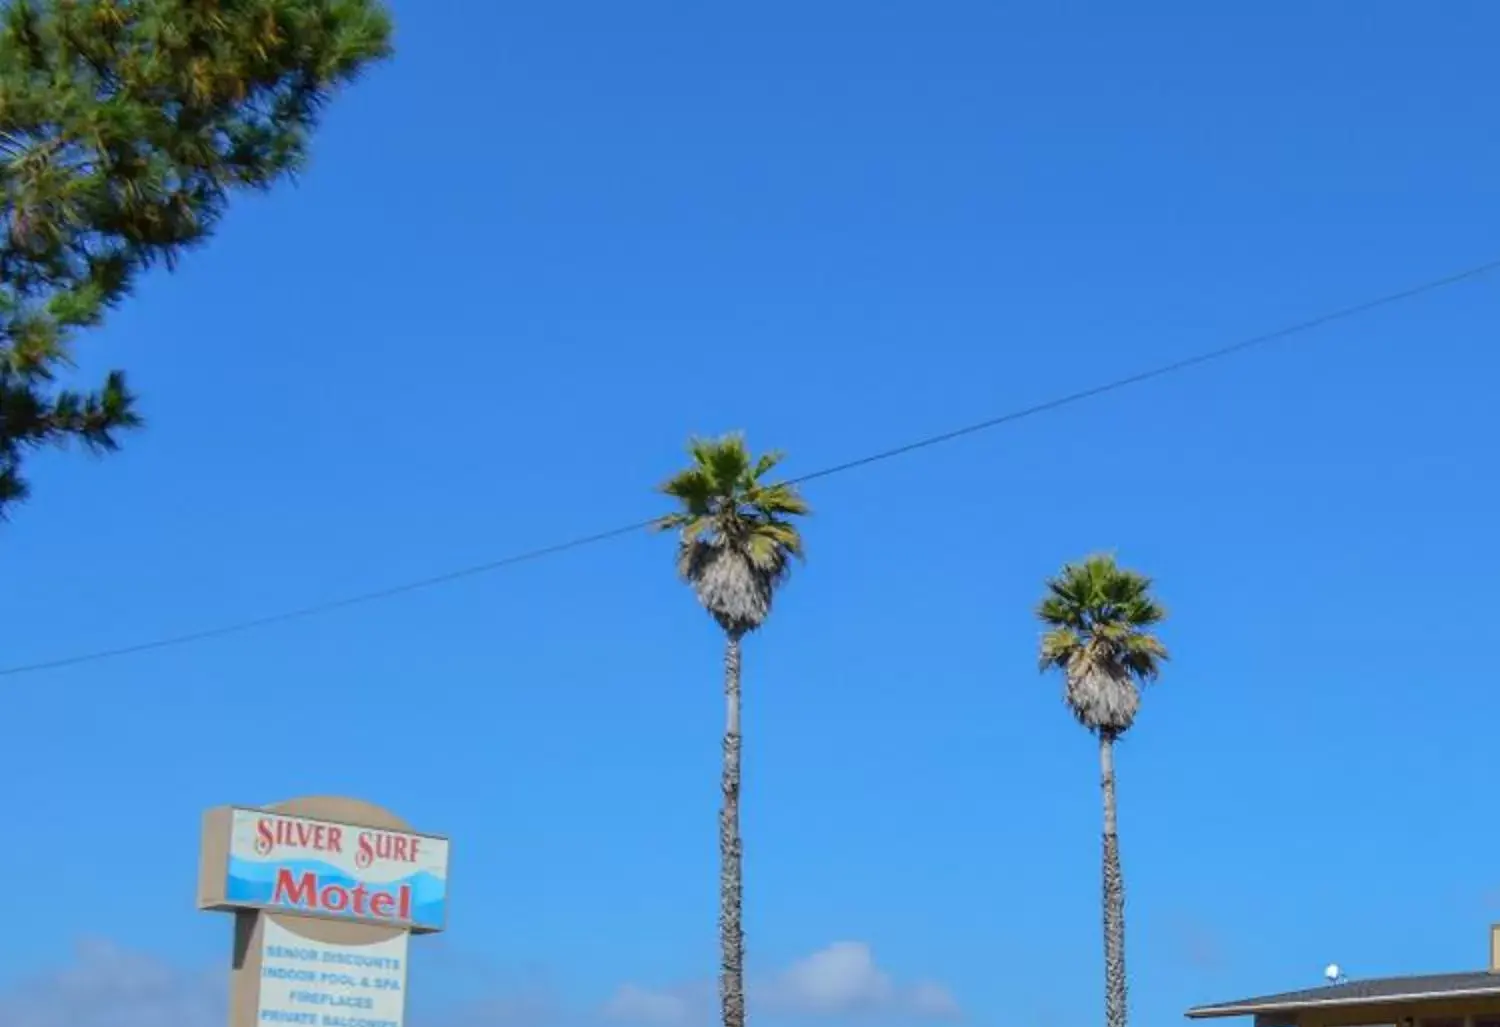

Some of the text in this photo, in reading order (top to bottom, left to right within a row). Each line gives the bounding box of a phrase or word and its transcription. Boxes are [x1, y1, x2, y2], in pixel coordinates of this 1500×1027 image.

[255, 818, 422, 869] SILVER SURF
[274, 868, 411, 919] Motel
[267, 946, 400, 970] SENIOR DISCOUNTS
[263, 967, 401, 991] INDOOR POOL & SPA
[289, 990, 374, 1010] FIREPLACES
[260, 1009, 318, 1025] PRIVATE
